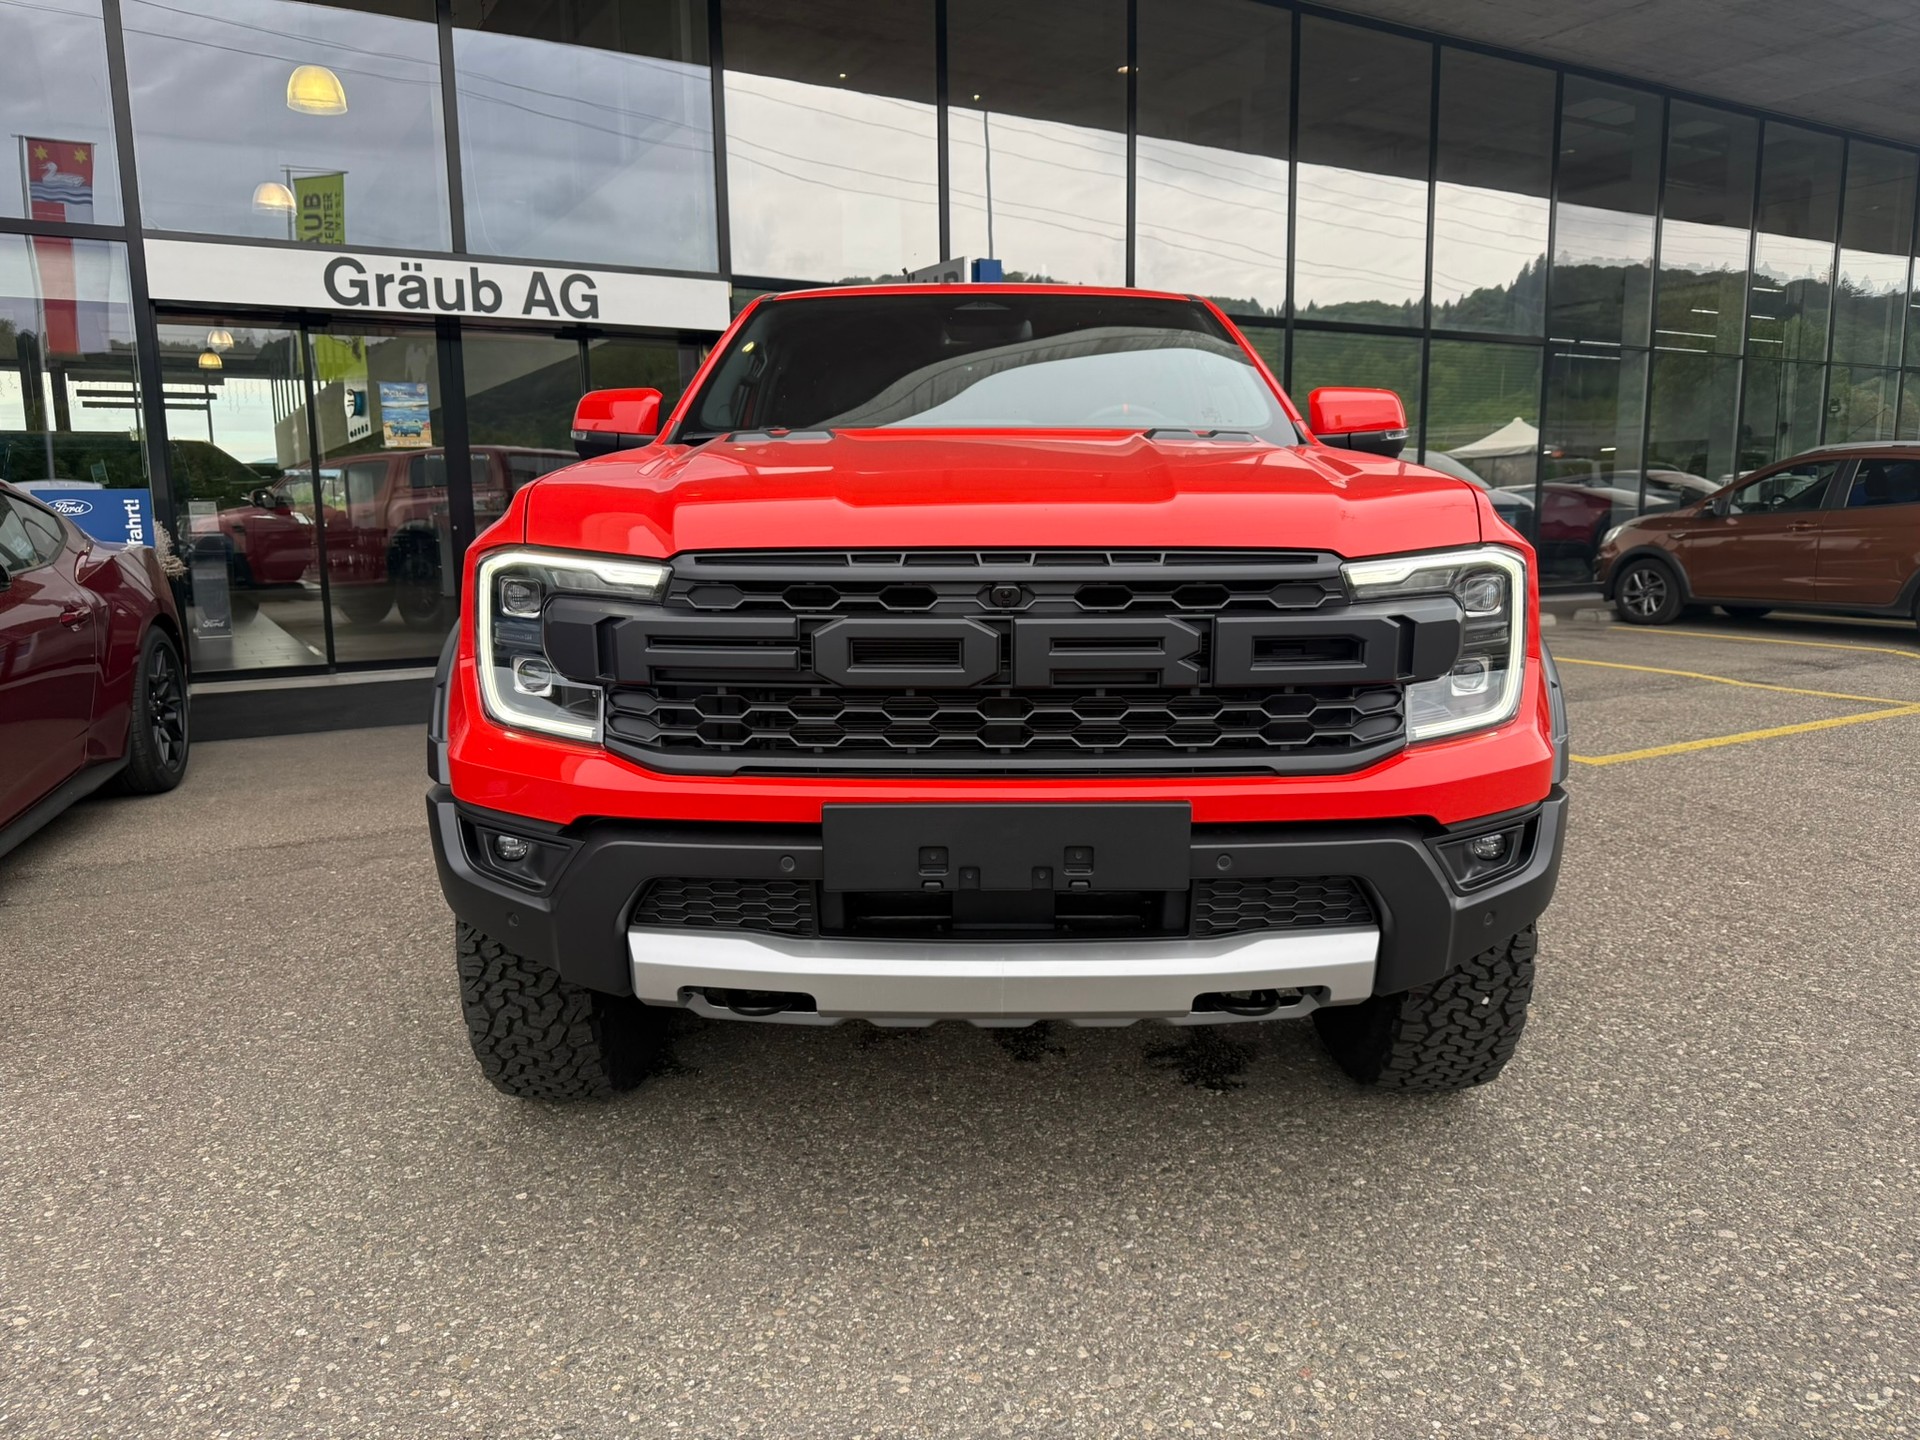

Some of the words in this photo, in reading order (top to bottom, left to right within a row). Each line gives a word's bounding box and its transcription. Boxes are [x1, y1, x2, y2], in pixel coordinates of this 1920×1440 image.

[324, 257, 503, 314] Gräub
[522, 271, 600, 320] AG
[53, 500, 84, 513] Ford
[123, 499, 143, 546] fahrt!
[610, 614, 1400, 688] FORD
